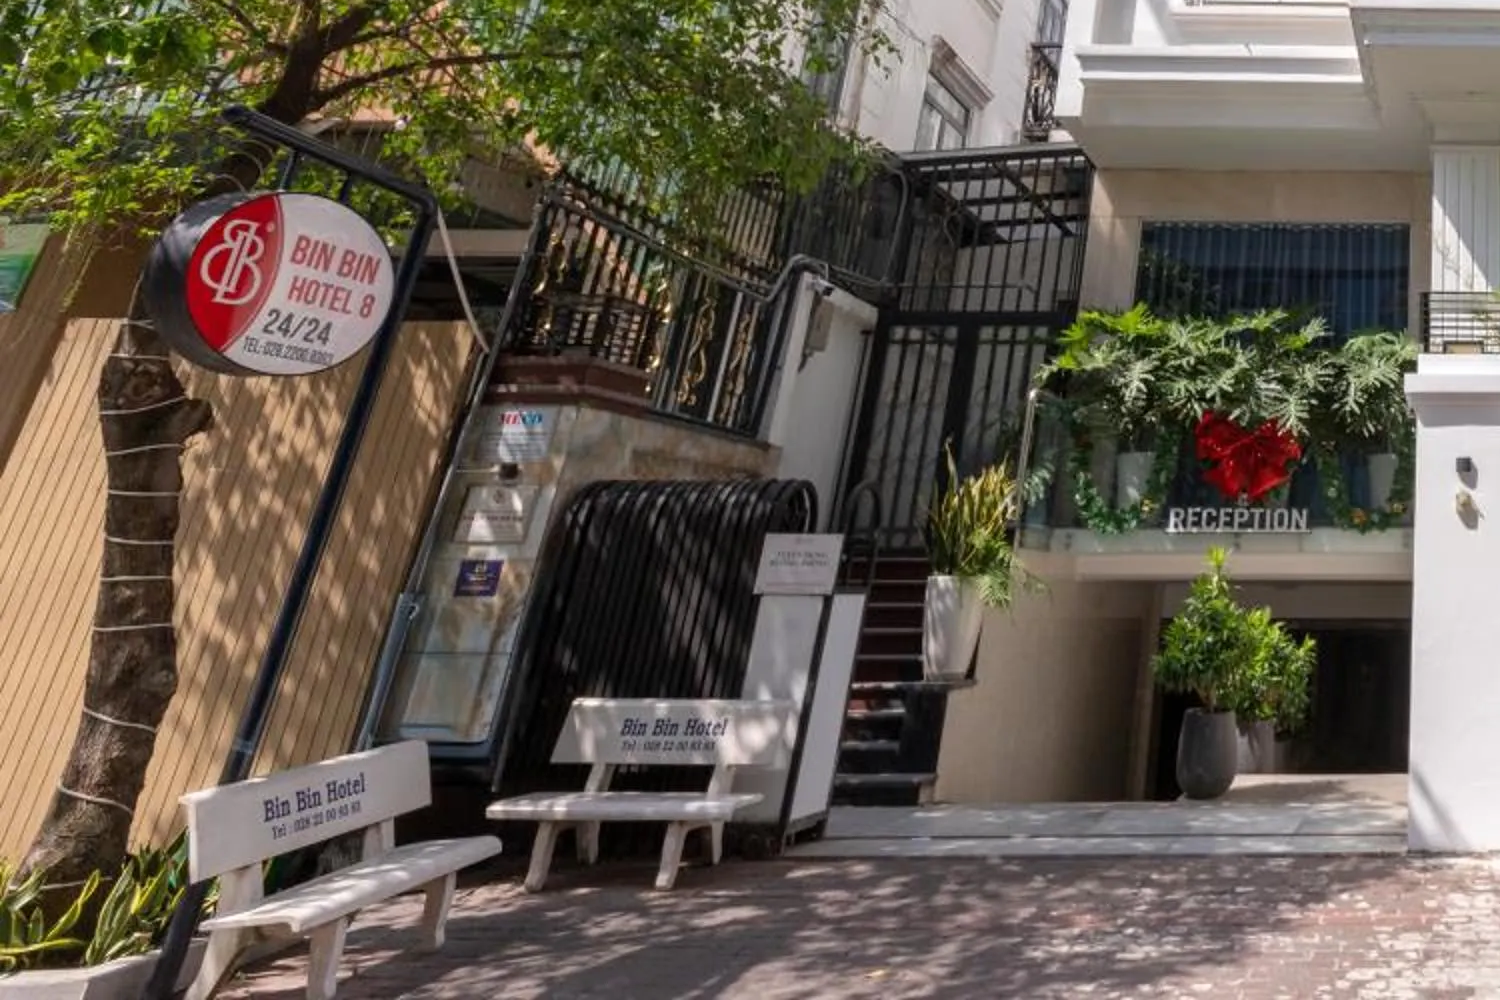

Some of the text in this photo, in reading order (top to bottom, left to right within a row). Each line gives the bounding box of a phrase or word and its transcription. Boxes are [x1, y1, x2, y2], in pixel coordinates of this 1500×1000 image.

[289, 233, 383, 286] BIN BIN
[287, 275, 376, 319] HOTEL 8
[262, 308, 334, 346] 24/24
[1168, 506, 1309, 532] RECEPTION
[619, 717, 729, 736] Bin Bin Hotel
[263, 771, 365, 823] Bin Bin Hotel
